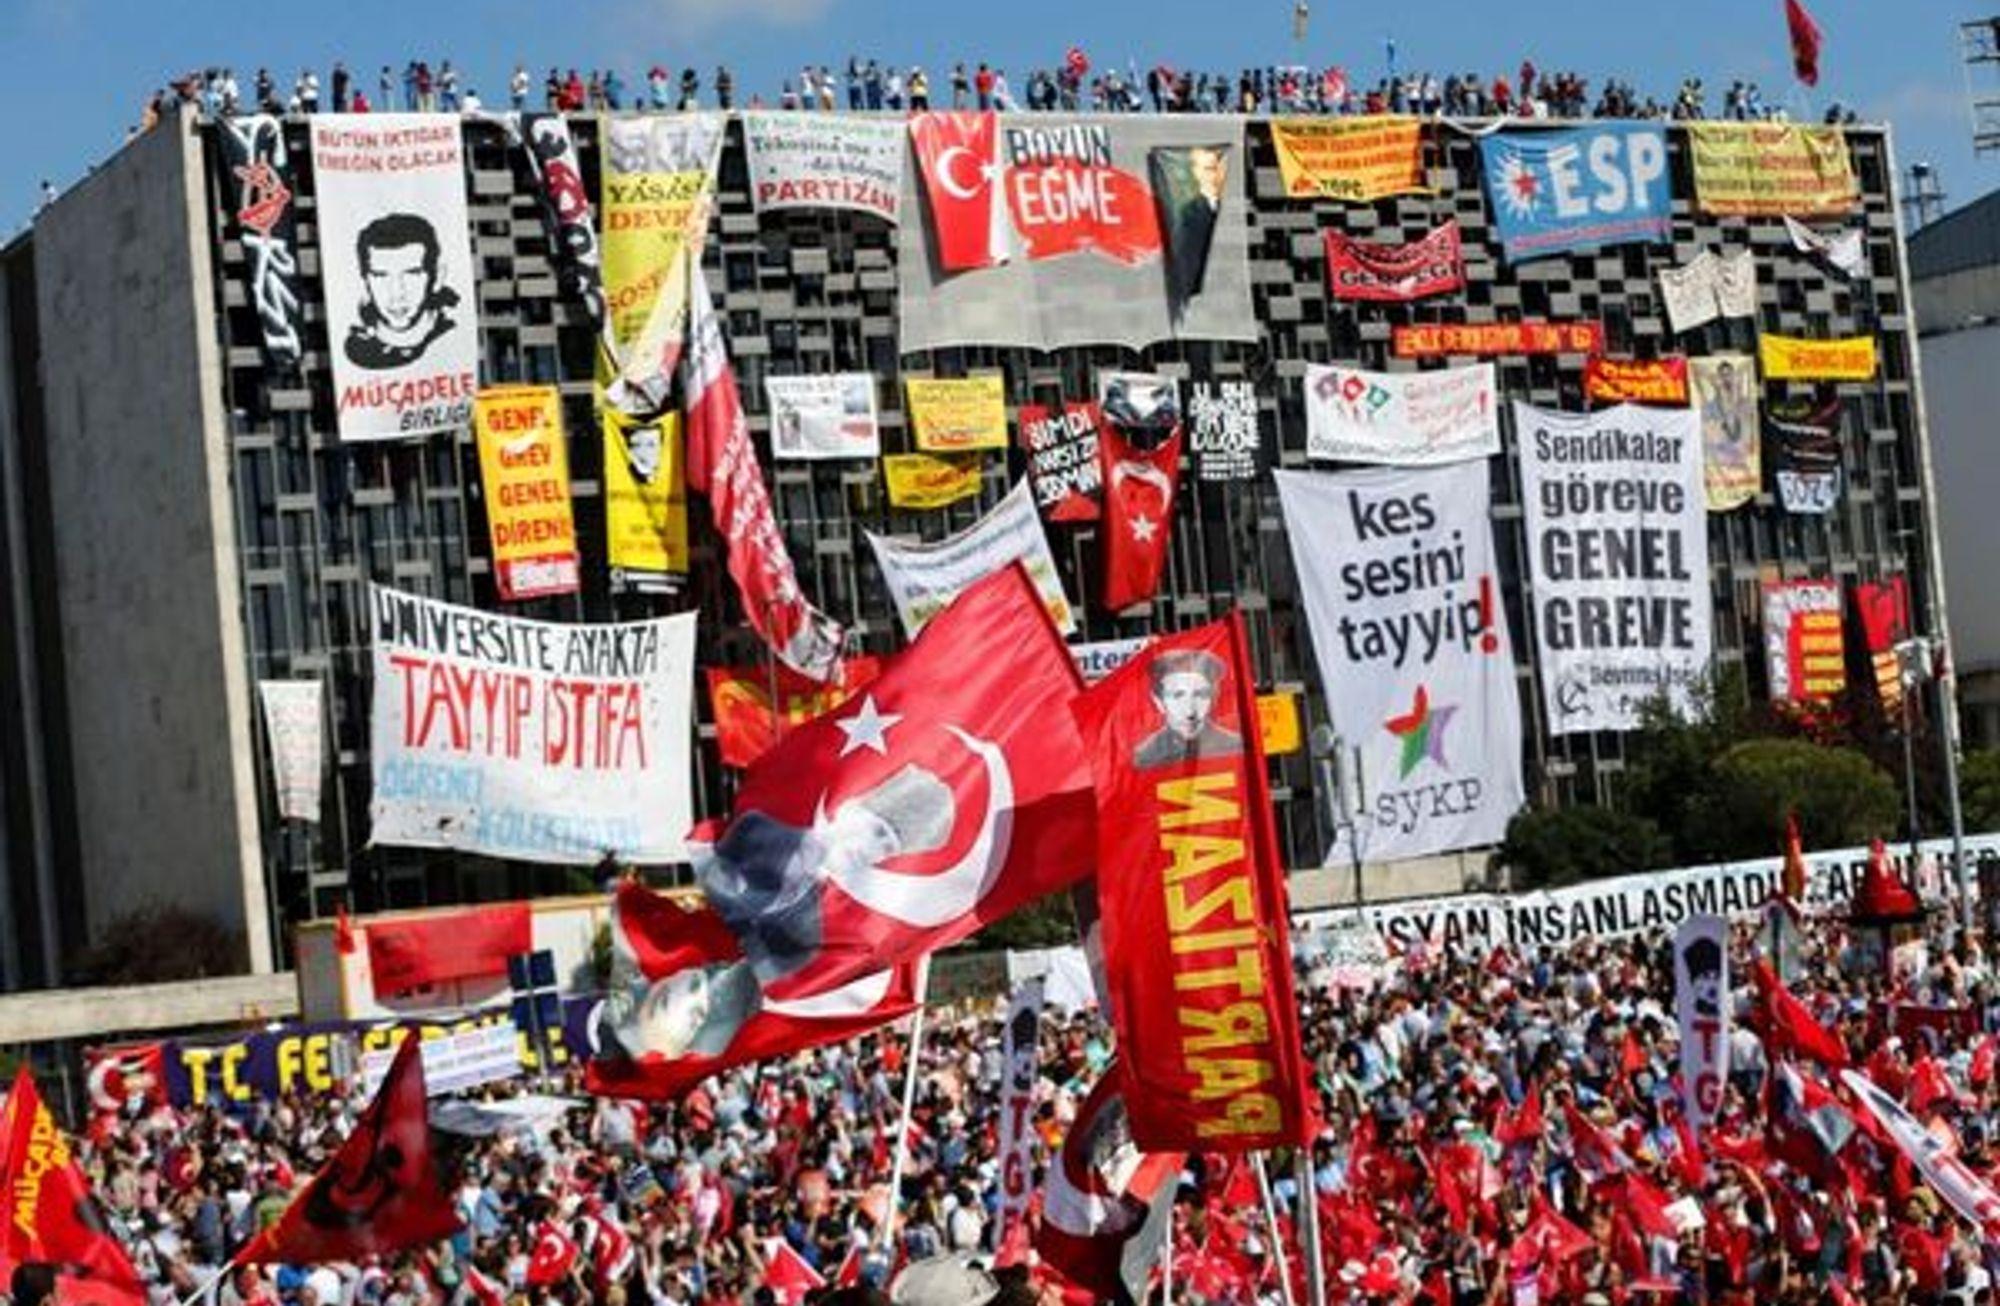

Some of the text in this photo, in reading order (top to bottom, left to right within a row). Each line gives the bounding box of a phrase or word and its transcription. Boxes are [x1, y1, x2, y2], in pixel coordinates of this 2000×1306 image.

[1007, 125, 1111, 167] BOYUN
[1016, 165, 1121, 224] EĞME
[1546, 132, 1665, 217] ESP
[1535, 427, 1683, 463] Sendikalar
[499, 480, 564, 507] GENEL
[1348, 488, 1436, 540] kes
[1541, 473, 1685, 519] göreve
[1341, 530, 1464, 601] sesini
[1541, 528, 1691, 581] GENEL
[1544, 596, 1693, 650] GREVE
[564, 624, 659, 676] AYAKTA
[1374, 908, 1491, 951] İSYAN
[182, 1043, 250, 1104] TC
